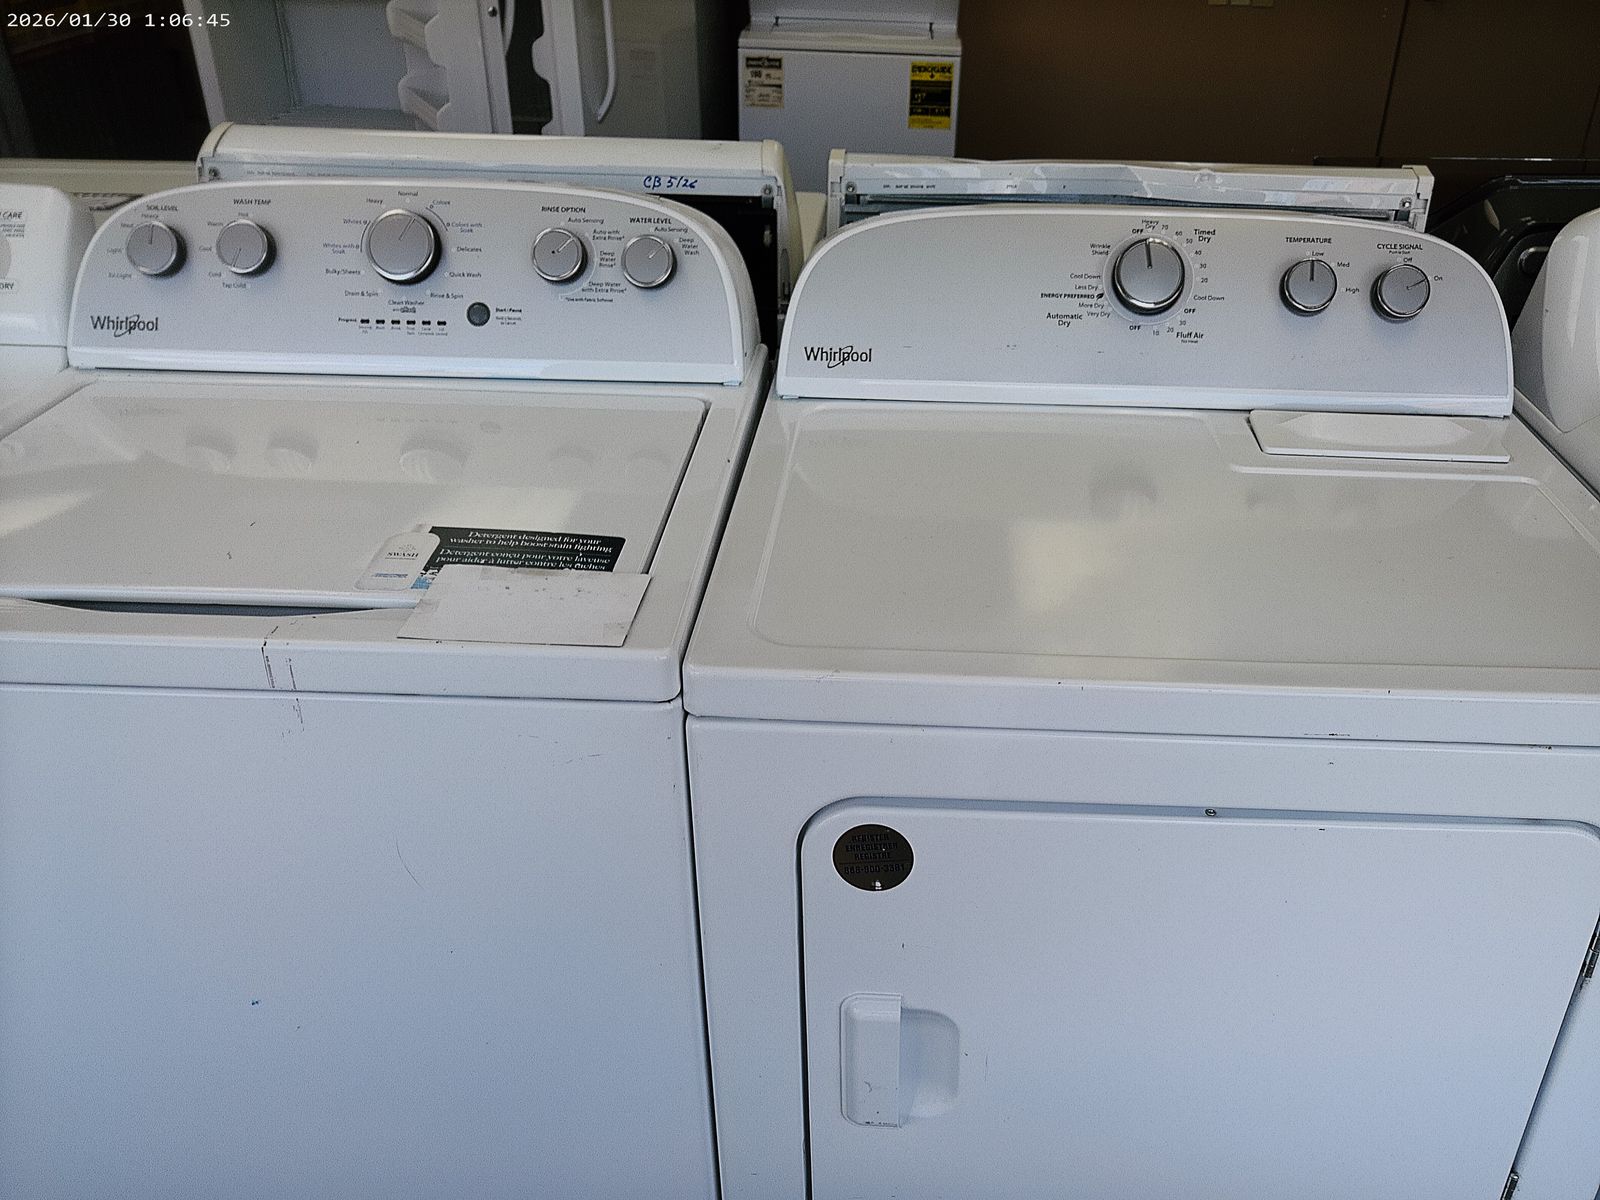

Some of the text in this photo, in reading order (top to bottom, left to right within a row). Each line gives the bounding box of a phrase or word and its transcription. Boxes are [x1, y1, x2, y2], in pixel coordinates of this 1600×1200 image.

[1285, 236, 1332, 244] TEMPERATURE
[1046, 312, 1083, 320] Automatic
[90, 314, 158, 337] Whirlpool
[1176, 331, 1192, 339] Fluff
[804, 345, 872, 368] Whirlpool
[468, 531, 518, 541] Detergent
[519, 534, 562, 542] designed
[574, 543, 613, 553] fighting
[439, 548, 489, 557] Detergent
[574, 556, 611, 564] laveuse
[851, 833, 890, 842] REGISTER
[845, 842, 898, 852] ENREGISTRER
[855, 852, 891, 861] REGISTRE
